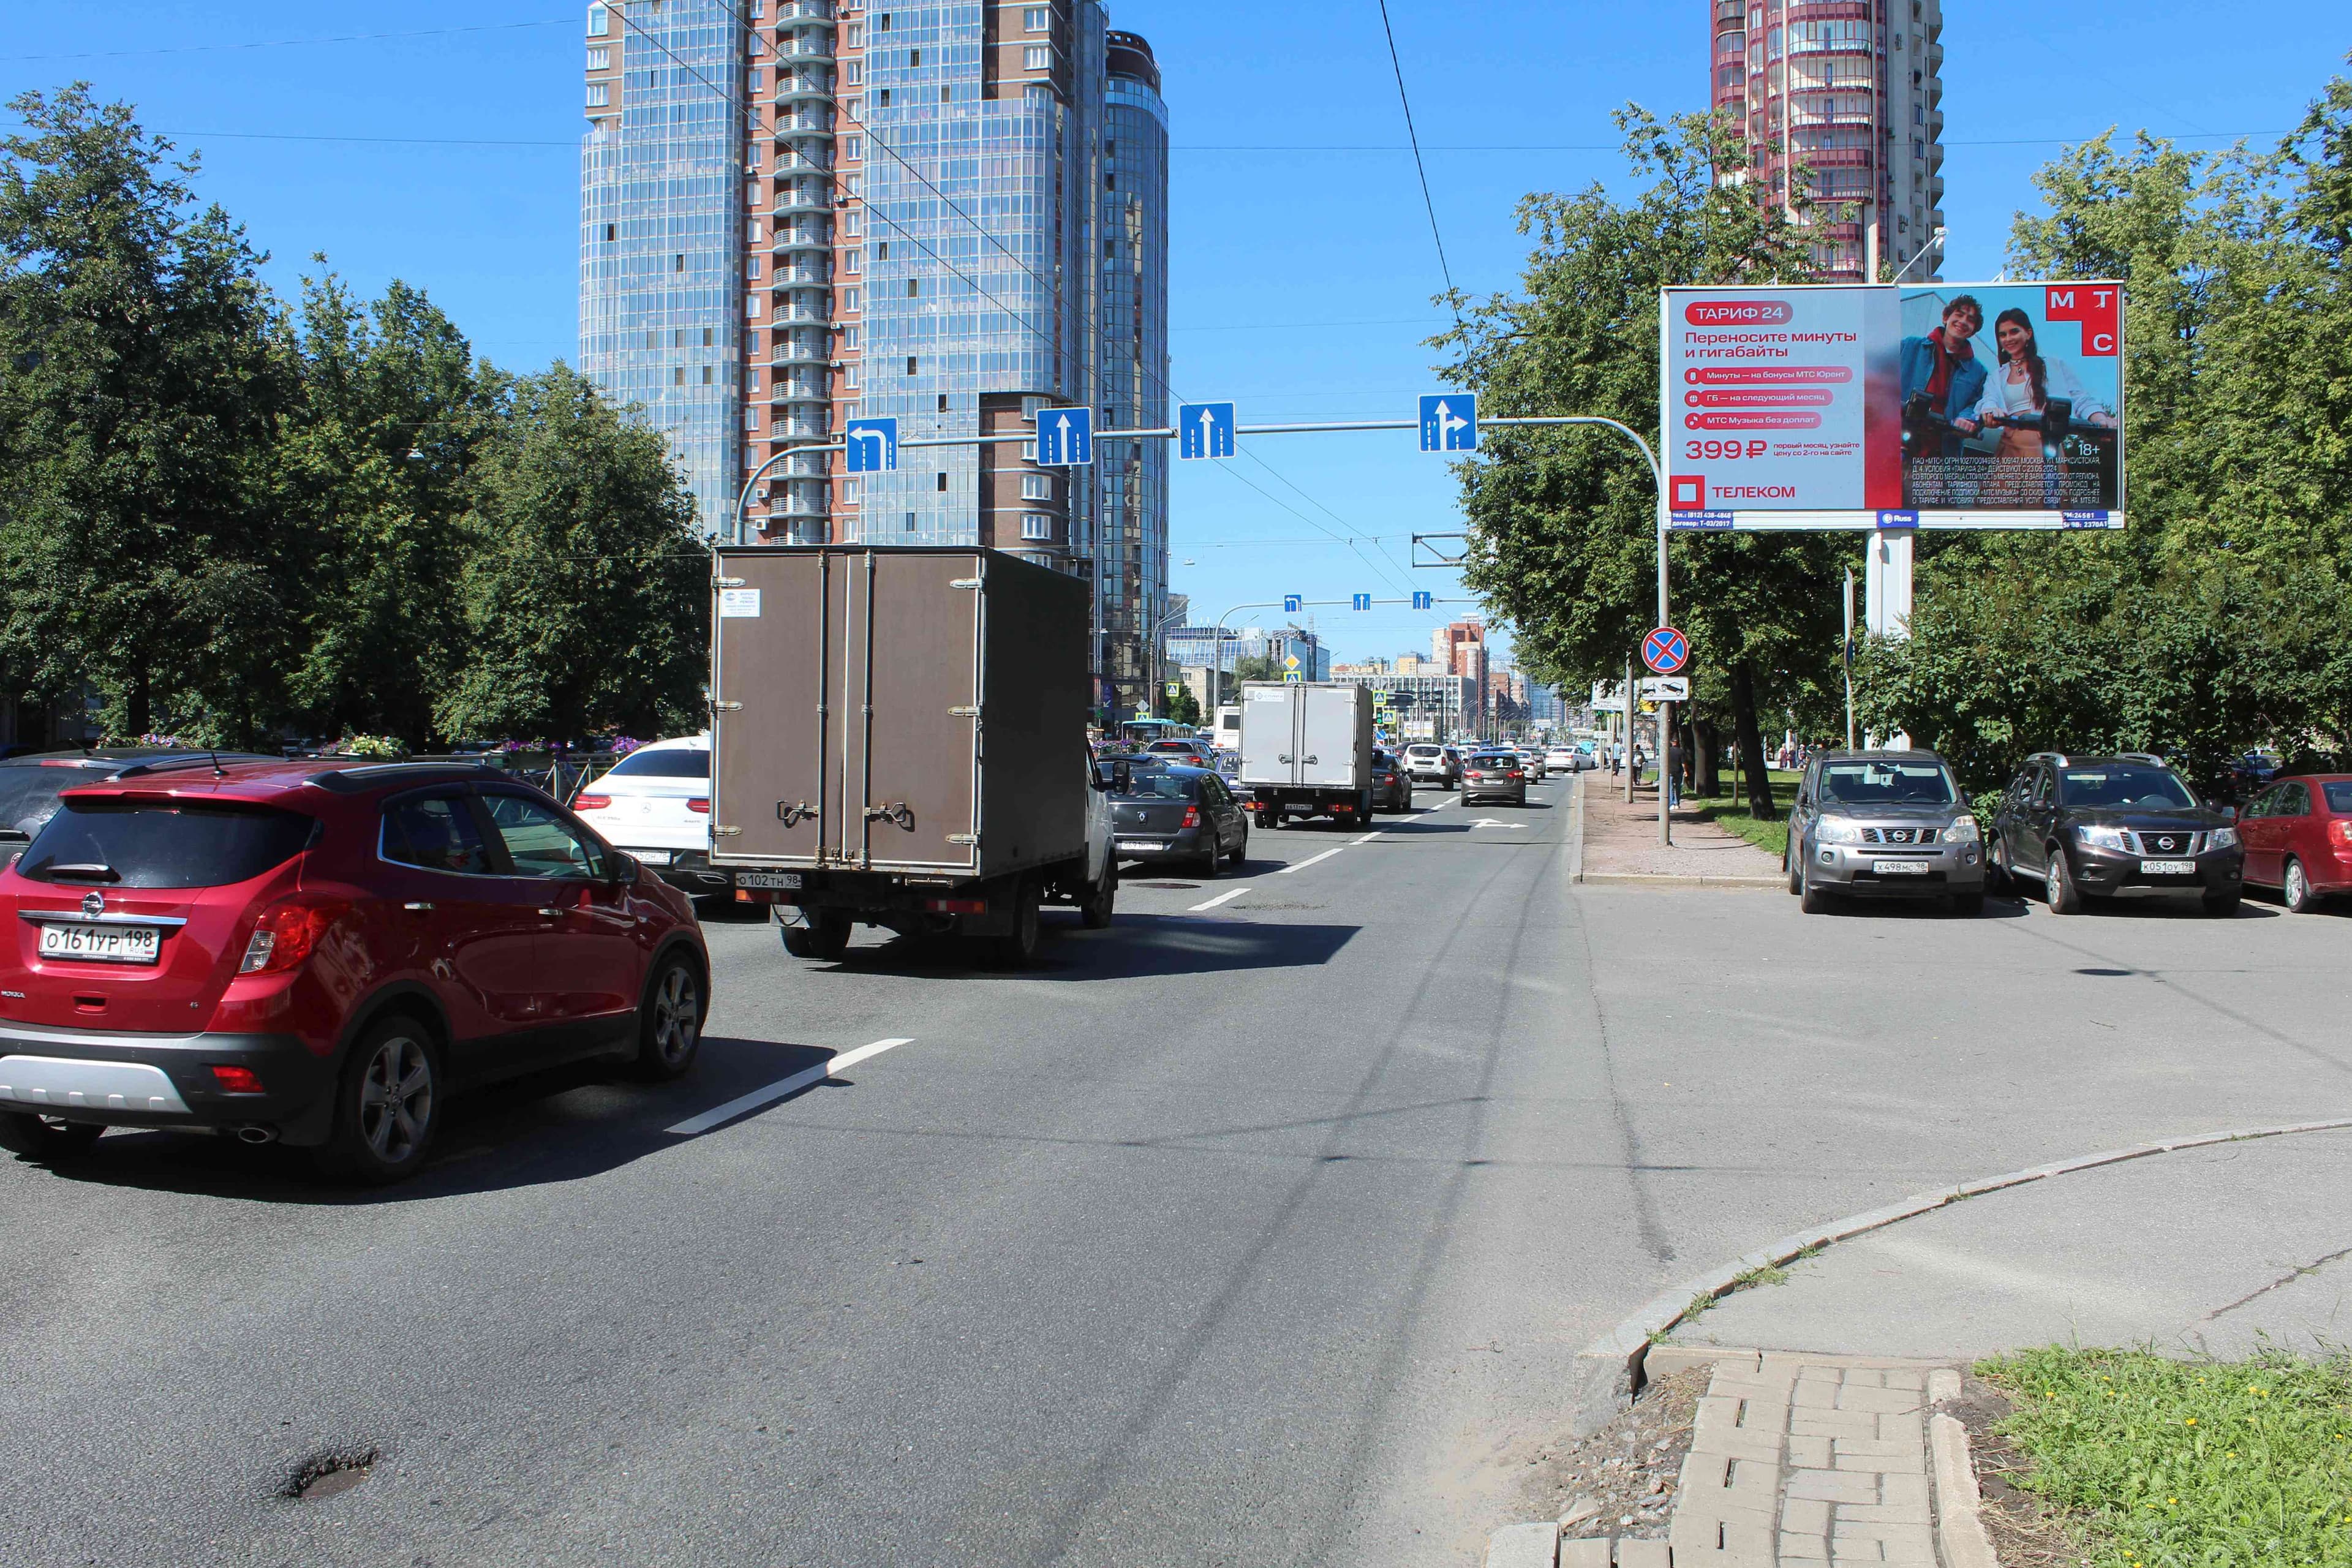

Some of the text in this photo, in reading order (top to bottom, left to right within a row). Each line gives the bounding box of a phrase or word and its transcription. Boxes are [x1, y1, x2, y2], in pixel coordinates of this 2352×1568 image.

[1695, 307, 1783, 320] ТАРИФ 24
[1685, 332, 1856, 345] Переносите минуты
[1686, 345, 1788, 358] и гигабайты
[1686, 440, 1742, 459] 399
[2078, 443, 2100, 456] 18+
[1712, 486, 1795, 498] ТЕЛЕКОМ
[125, 930, 153, 948] 198
